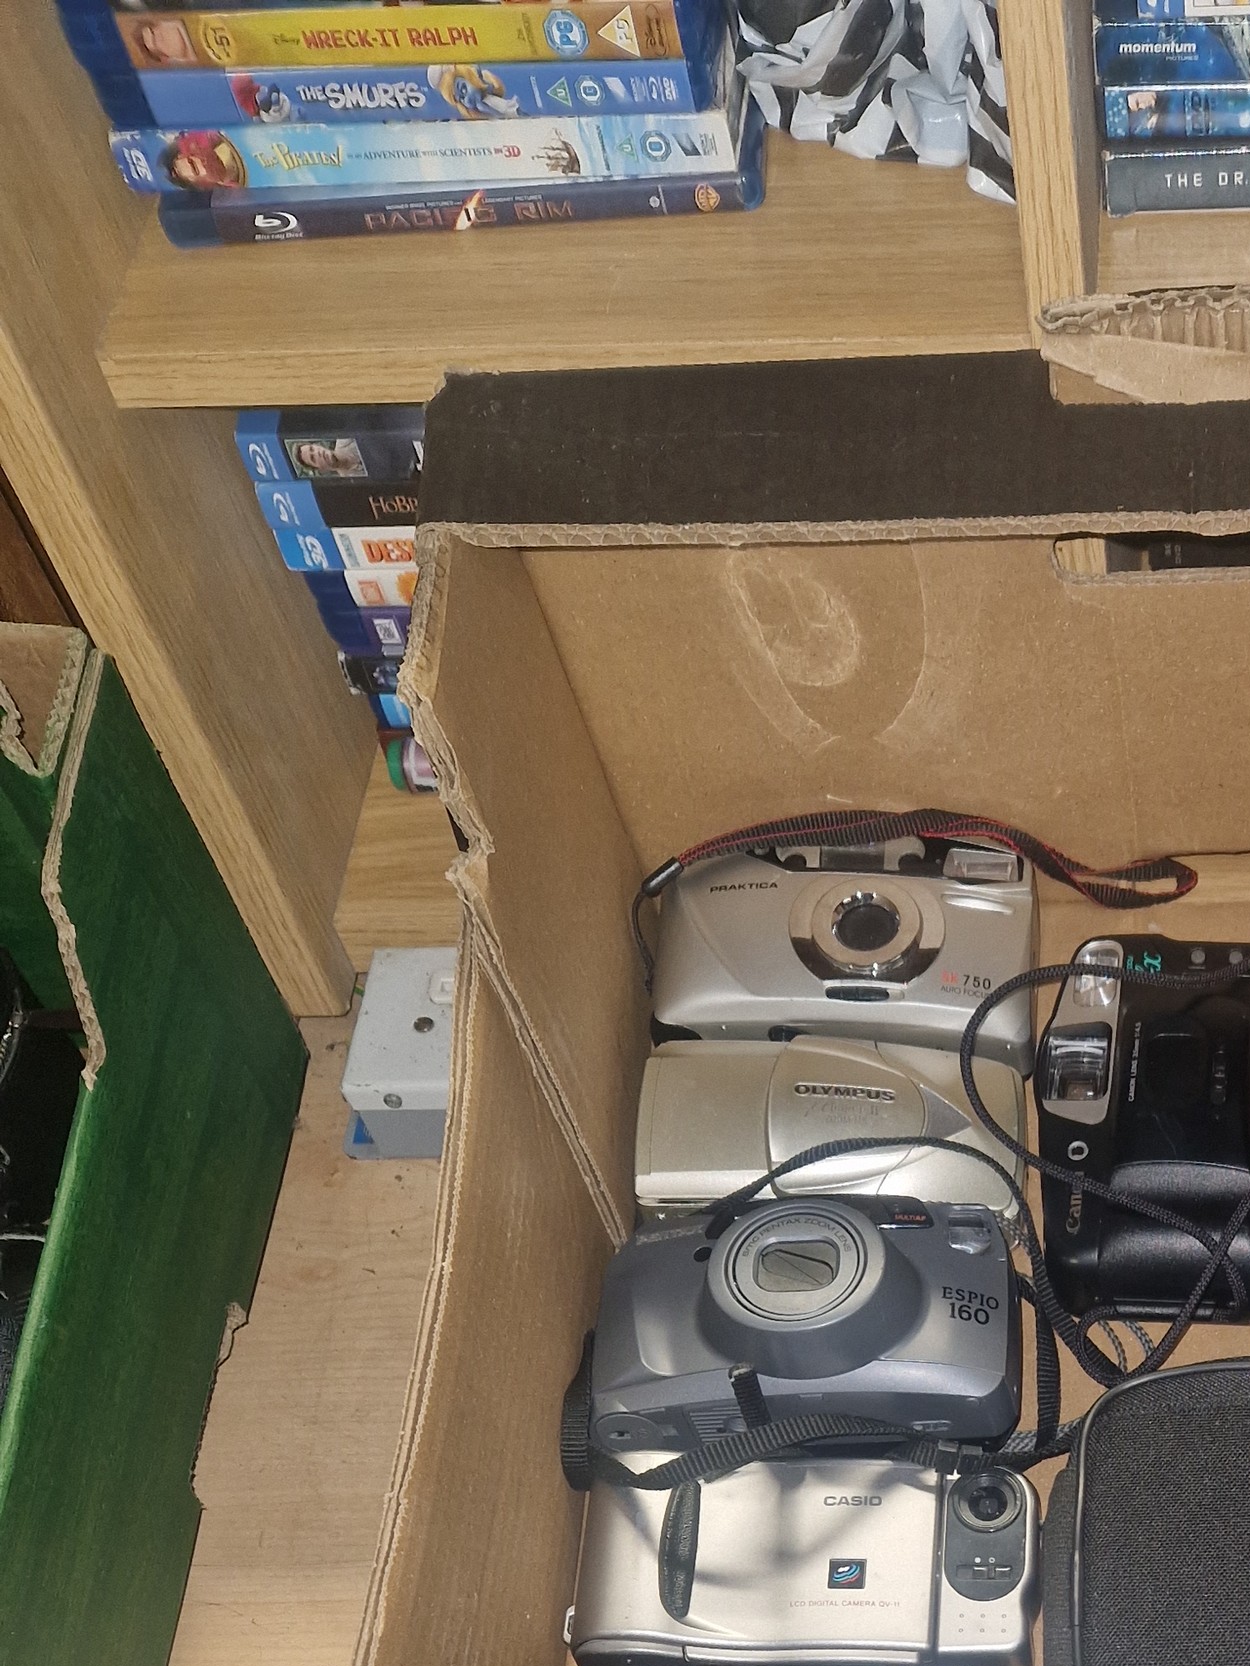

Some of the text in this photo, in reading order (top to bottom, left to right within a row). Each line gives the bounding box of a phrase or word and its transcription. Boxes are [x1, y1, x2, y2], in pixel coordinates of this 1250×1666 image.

[302, 26, 478, 50] WRECK-IT RALPH
[556, 19, 579, 48] PG
[615, 18, 635, 44] PG
[1118, 41, 1197, 56] momentum
[296, 81, 427, 110] THE SMURFS
[363, 150, 421, 160] ADVENTURE
[439, 147, 493, 158] SCIENTISTS
[503, 145, 521, 158] 3D
[1164, 172, 1204, 189] THE
[1218, 172, 1248, 188] DR.
[363, 200, 572, 231] PACIFIC RIM
[361, 538, 415, 564] DES
[709, 881, 779, 893] PRAKTICA
[940, 985, 960, 995] AUTO
[963, 974, 992, 990] 750
[794, 1082, 896, 1102] OLYMPUS
[759, 1217, 852, 1253] PENTAX ZOOM LENS
[941, 1286, 1000, 1312] ESPIO
[948, 1302, 991, 1325] 160
[823, 1495, 883, 1507] CASIO
[789, 1600, 806, 1608] LCD
[808, 1600, 840, 1608] DIGITAL
[841, 1600, 876, 1608] CAMERA
